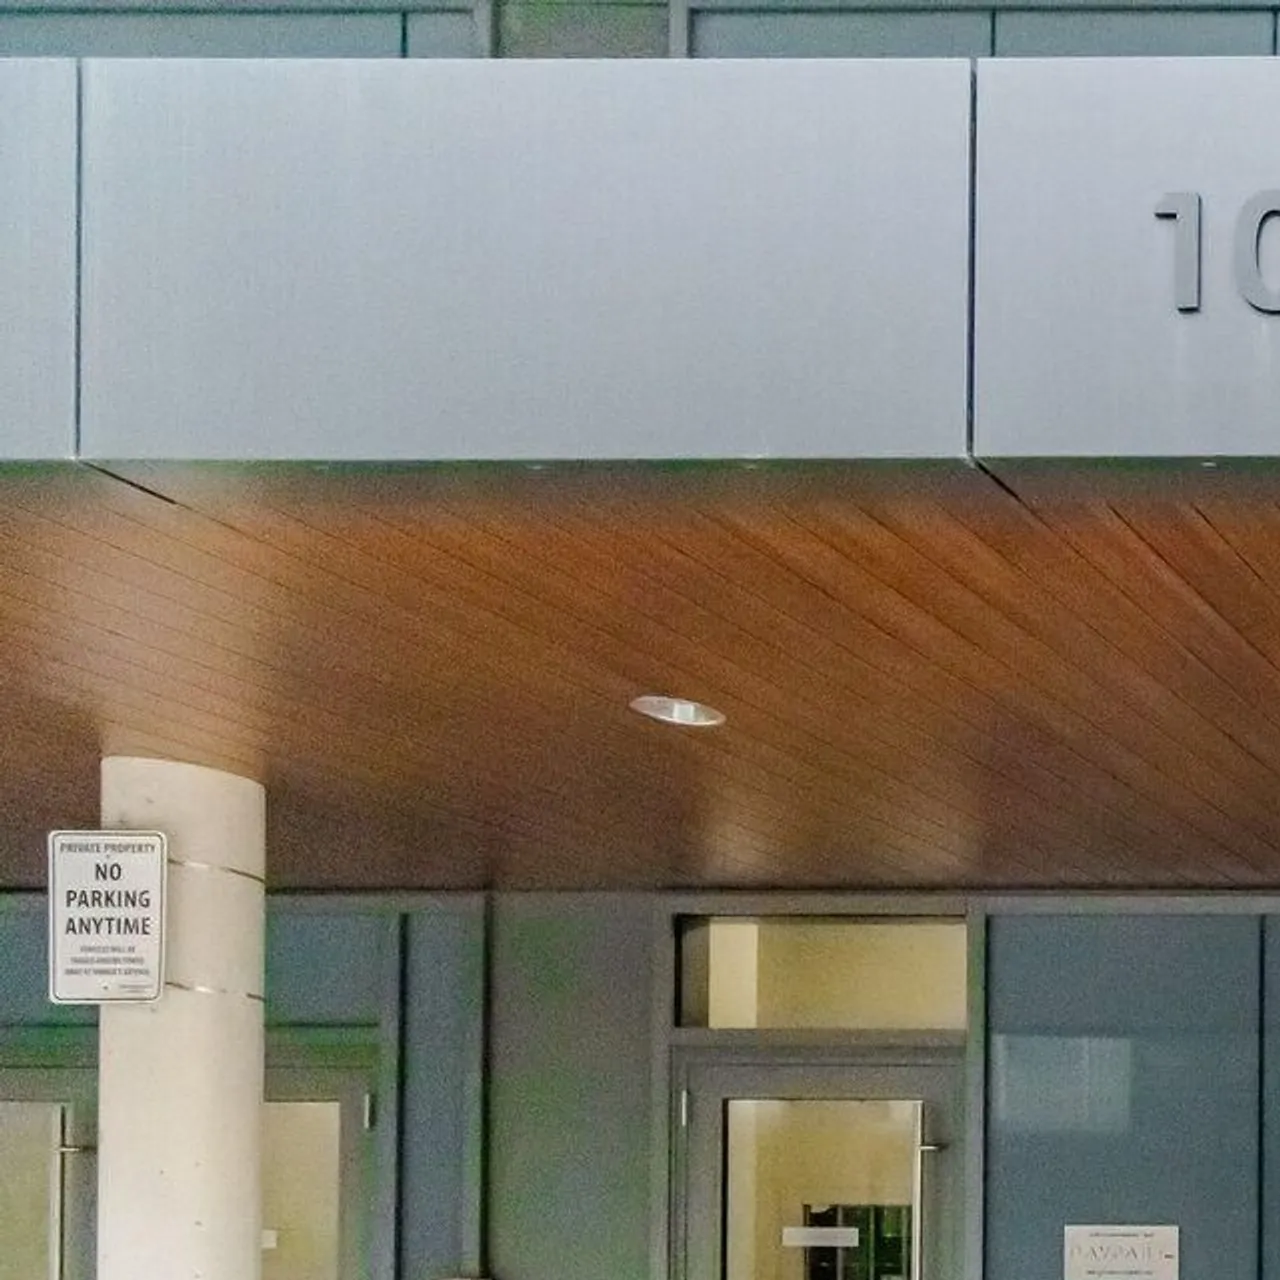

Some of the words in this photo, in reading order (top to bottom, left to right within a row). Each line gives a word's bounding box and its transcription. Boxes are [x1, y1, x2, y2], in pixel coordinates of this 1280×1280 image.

[95, 863, 121, 881] NO
[66, 890, 150, 908] PARKING
[65, 917, 150, 935] ANYTIME
